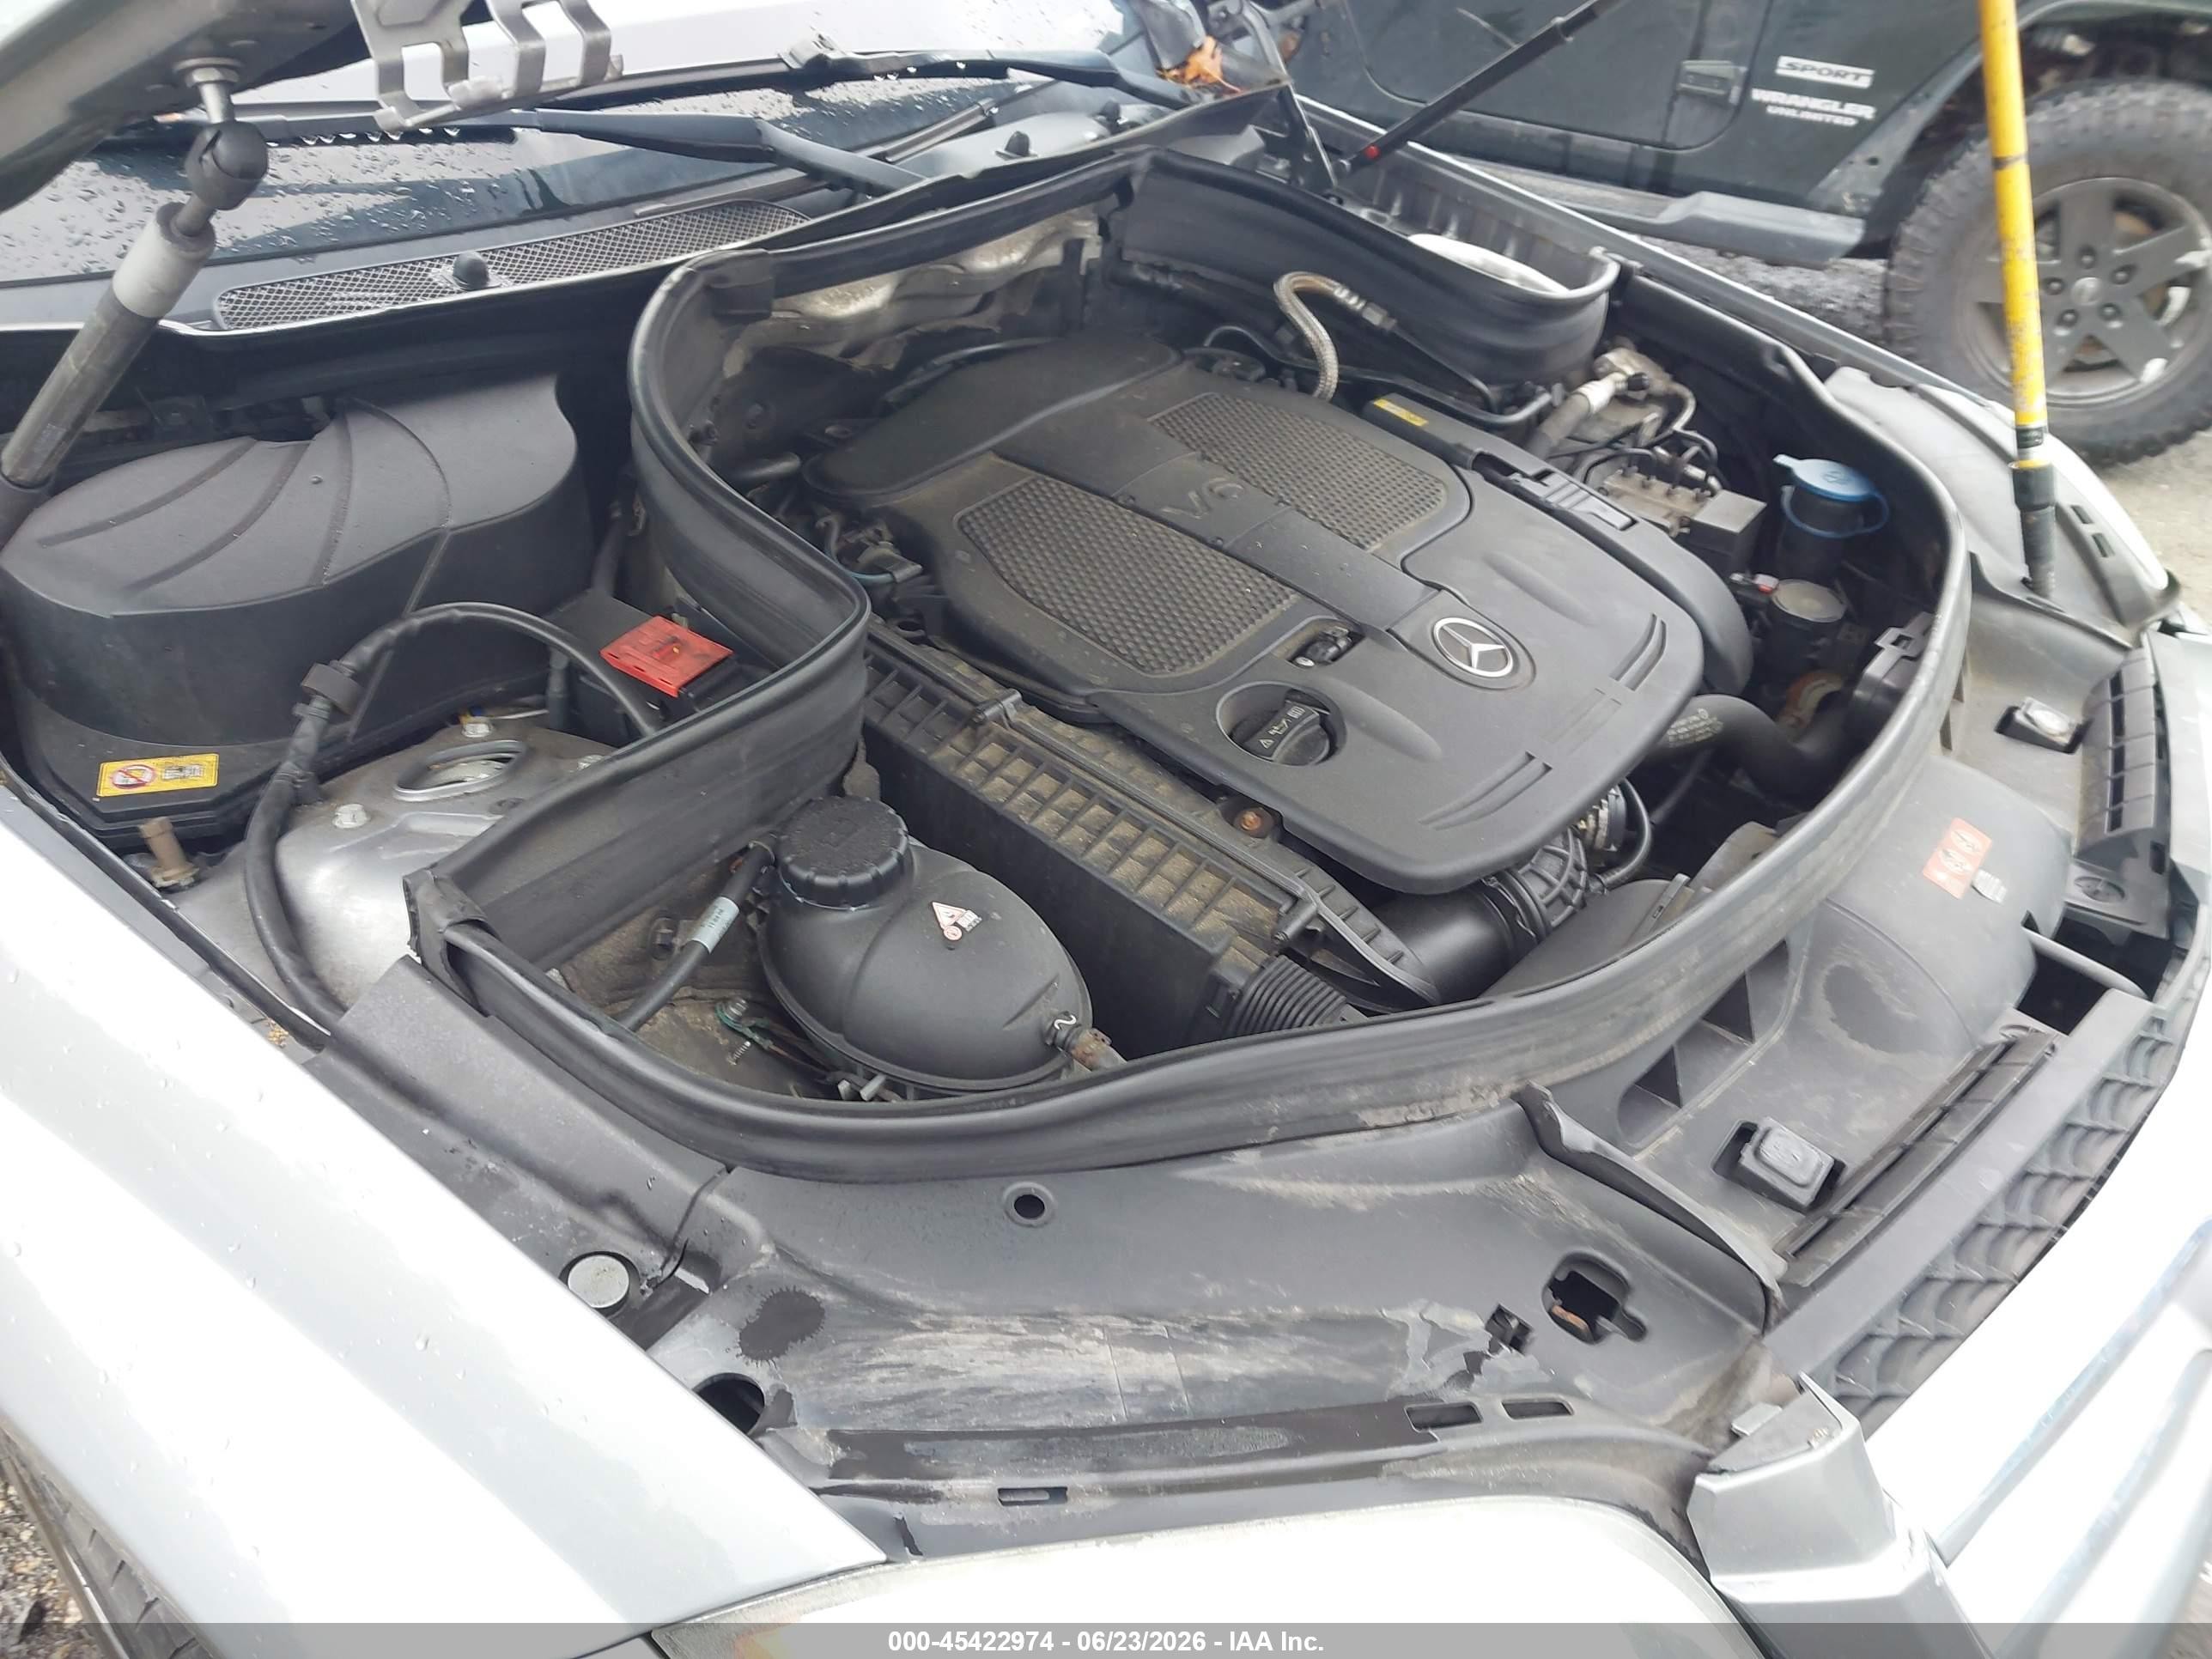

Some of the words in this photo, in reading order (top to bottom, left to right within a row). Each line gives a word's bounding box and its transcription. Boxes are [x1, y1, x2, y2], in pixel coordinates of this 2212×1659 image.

[1784, 60, 1865, 82] SPORT
[1751, 88, 1876, 119] WRANGLER
[1765, 104, 1858, 127] UNLIMITED
[1161, 477, 1244, 520] V6
